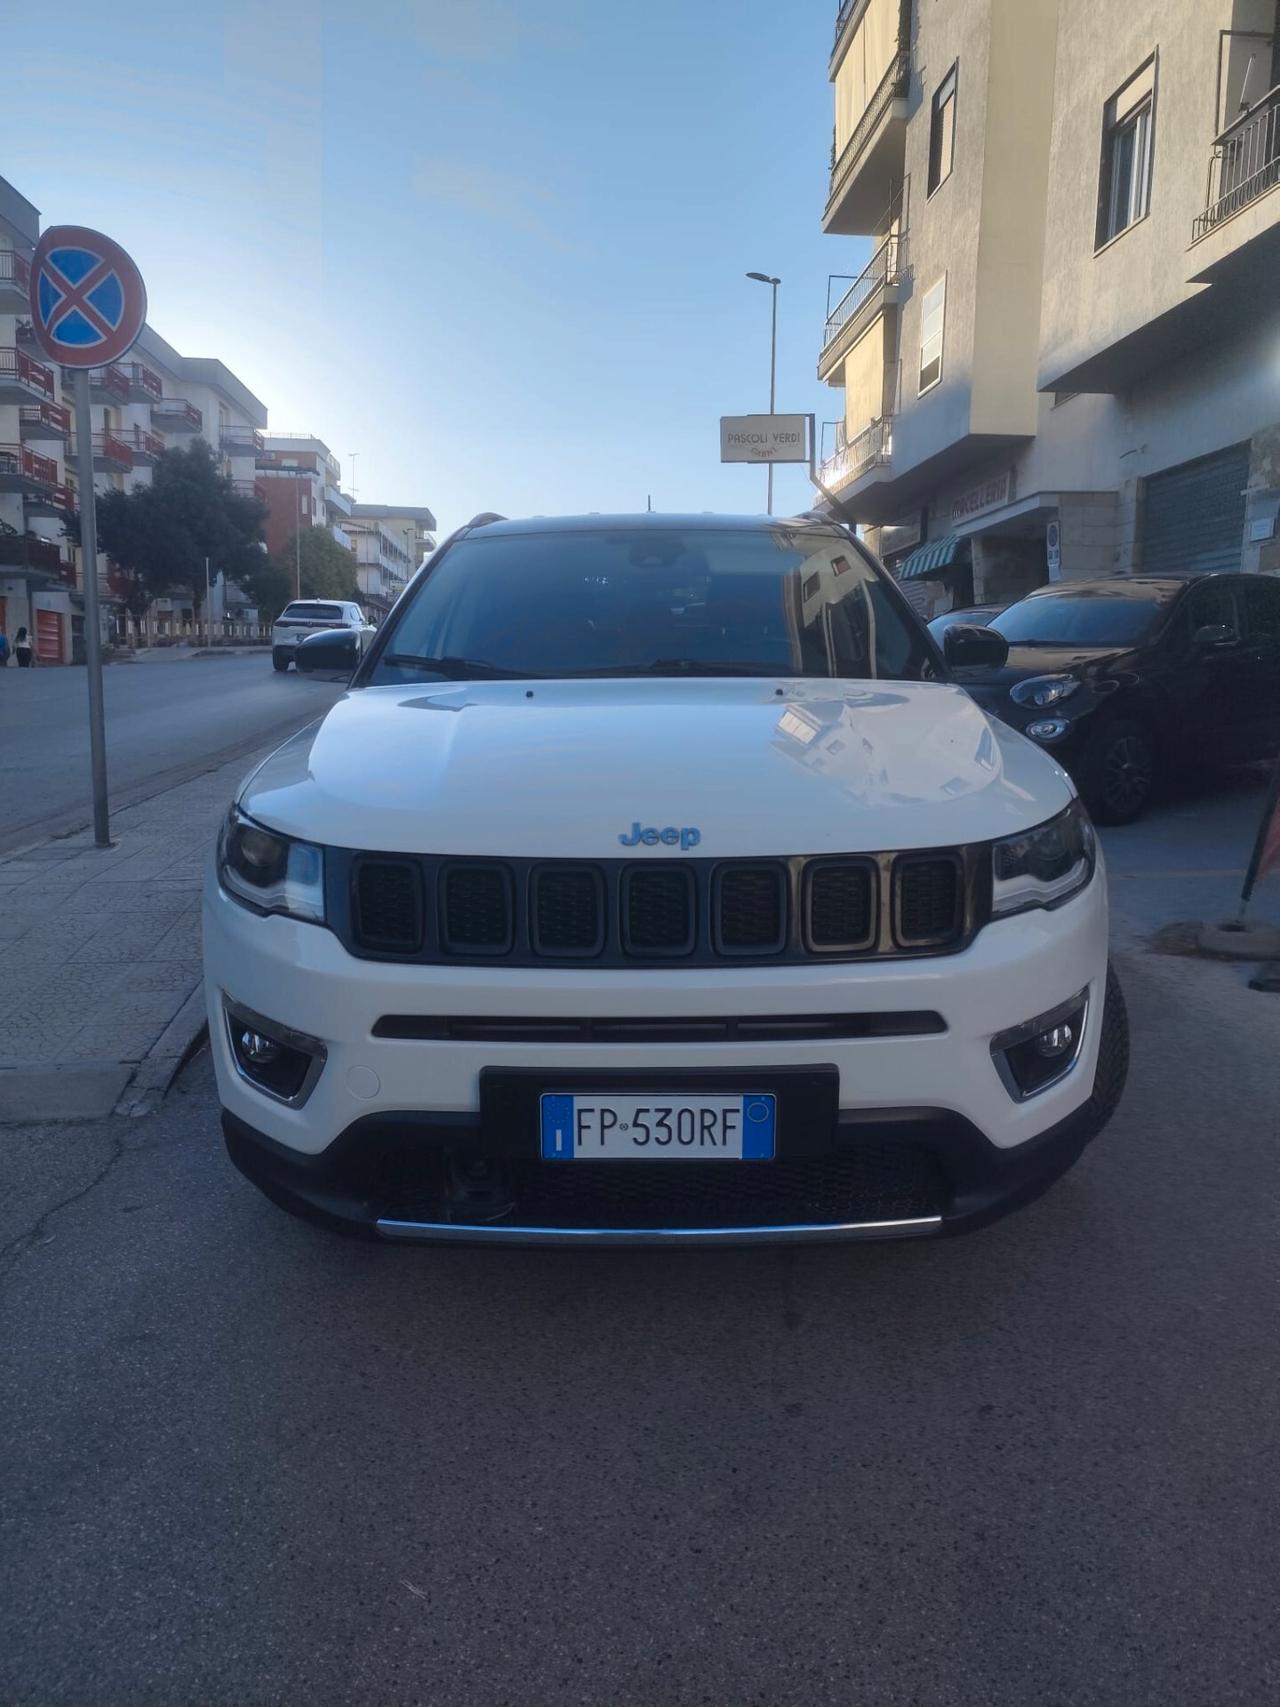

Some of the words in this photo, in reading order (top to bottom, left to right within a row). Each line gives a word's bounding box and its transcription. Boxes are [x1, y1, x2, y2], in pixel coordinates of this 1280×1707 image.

[727, 432, 768, 444] PASCOLI
[772, 431, 801, 443] VERDI
[618, 822, 701, 851] Jeep
